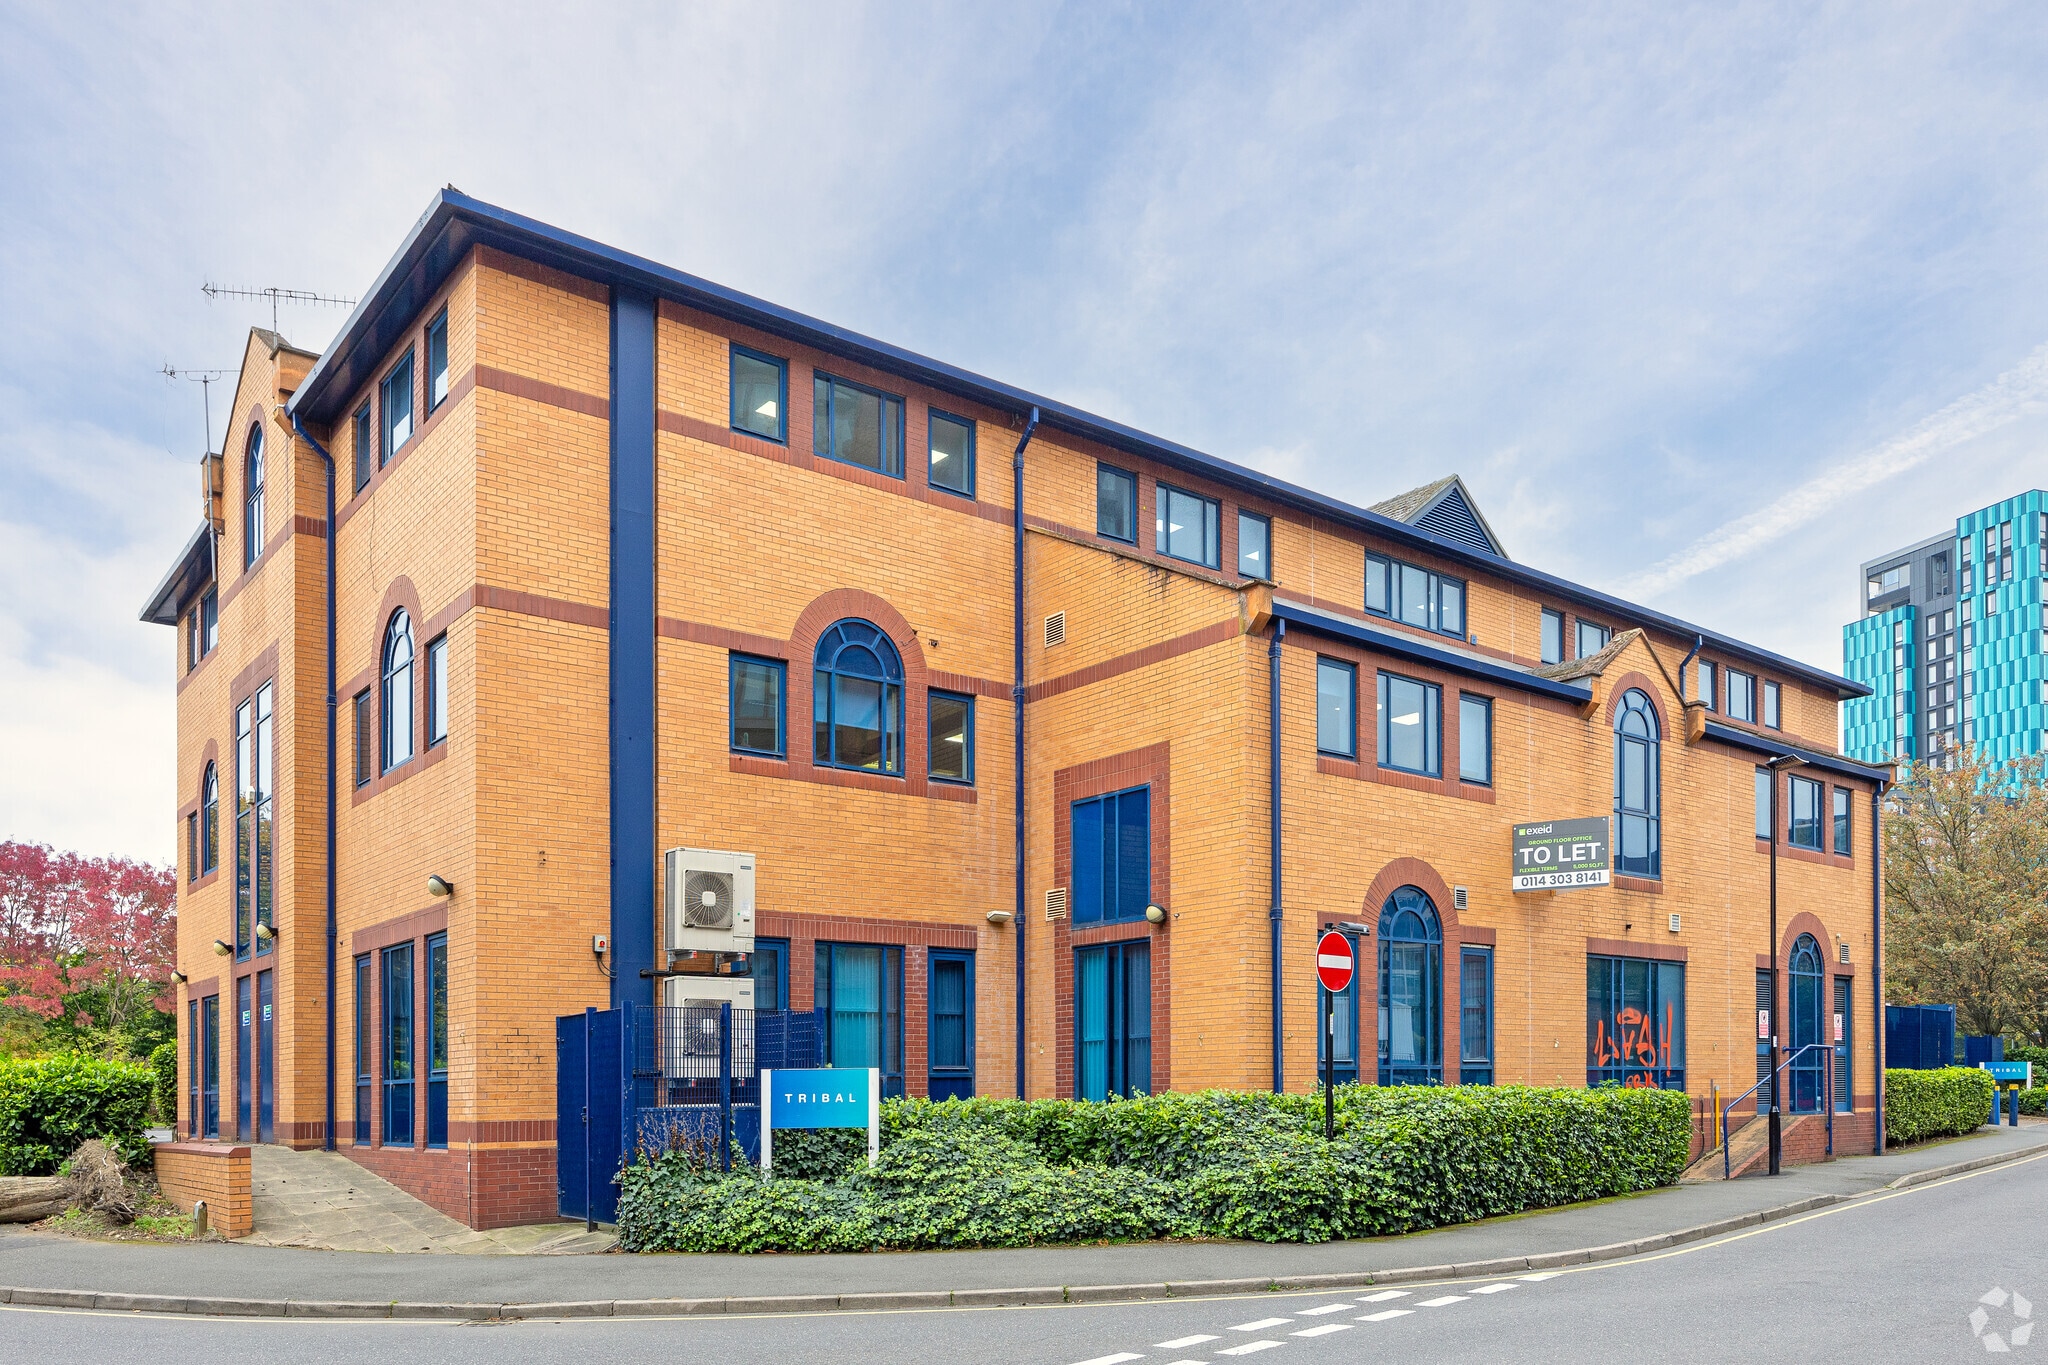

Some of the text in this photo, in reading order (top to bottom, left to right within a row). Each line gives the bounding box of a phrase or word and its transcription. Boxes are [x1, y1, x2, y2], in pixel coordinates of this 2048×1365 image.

[1526, 824, 1552, 835] exeid
[1520, 842, 1601, 864] TO LET
[1521, 872, 1602, 887] 0114 303 8141
[784, 1093, 856, 1103] TRIBAL
